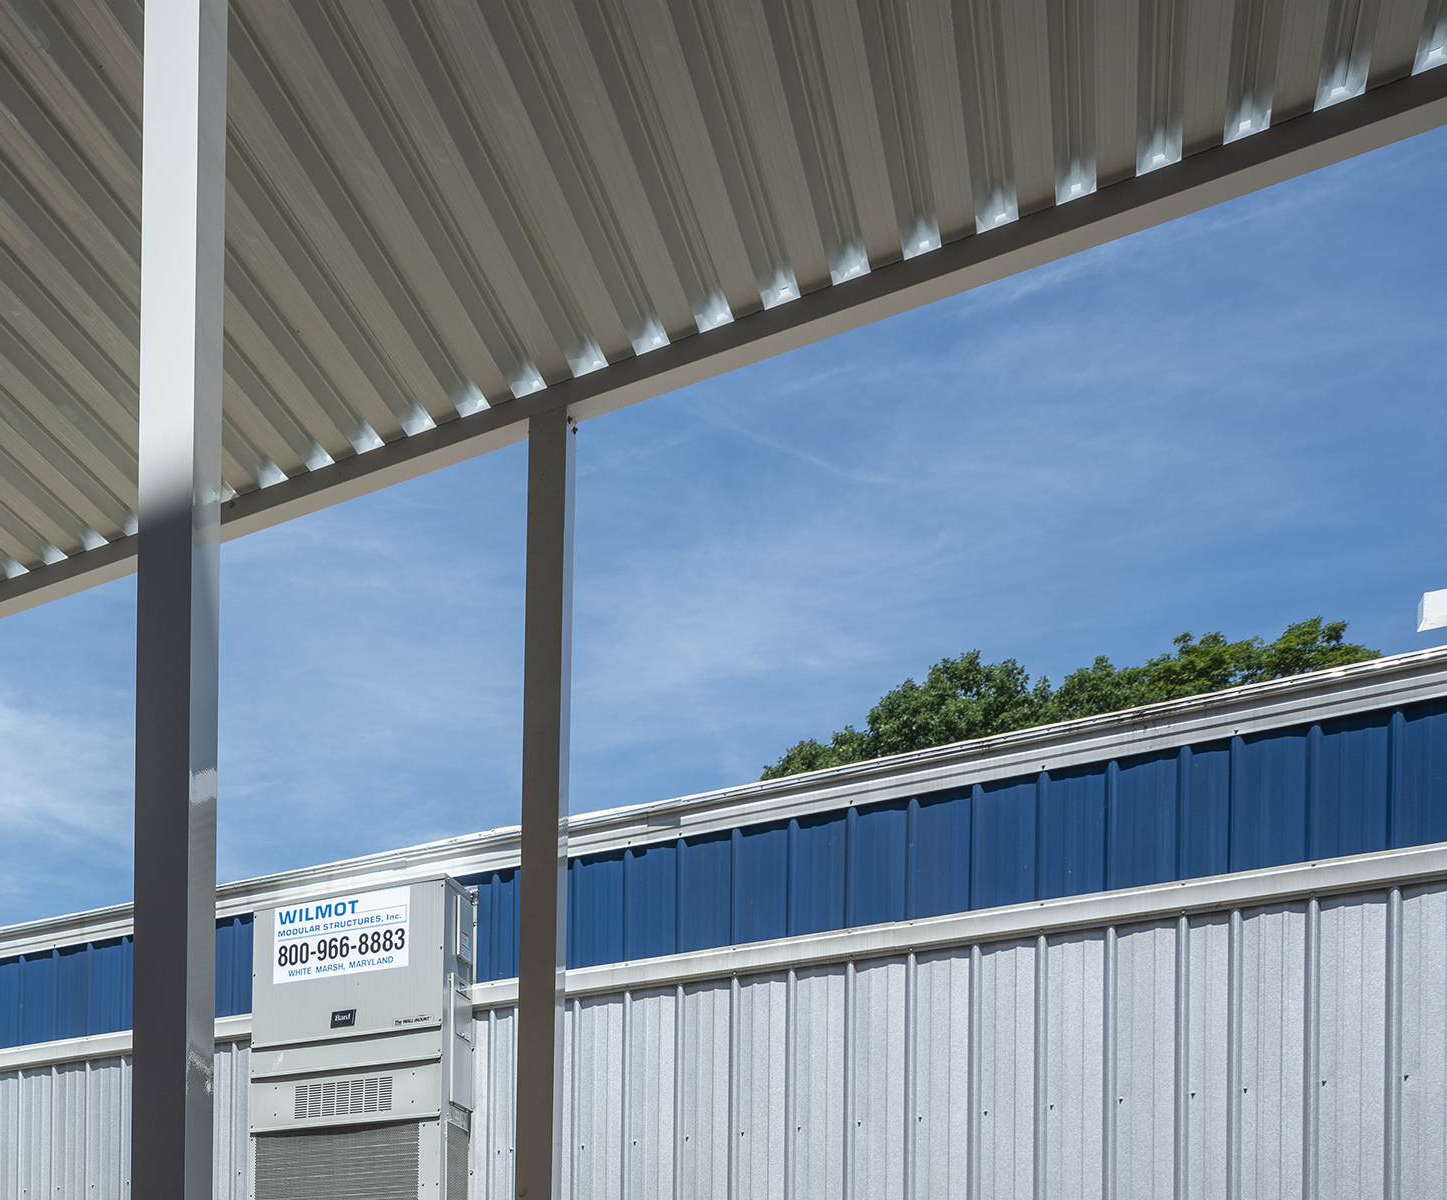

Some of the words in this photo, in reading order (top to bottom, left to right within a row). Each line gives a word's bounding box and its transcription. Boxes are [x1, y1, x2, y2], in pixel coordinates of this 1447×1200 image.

[279, 900, 359, 925] WILMOT
[278, 925, 321, 937] MODULAR
[323, 915, 384, 931] STRUCTURES,
[386, 913, 402, 921] Inc.
[278, 928, 405, 967] 800-966-8883
[288, 967, 312, 977] WHITE
[315, 963, 346, 974] MARSH,
[349, 956, 394, 969] MARYLAND
[334, 1013, 351, 1022] Bard
